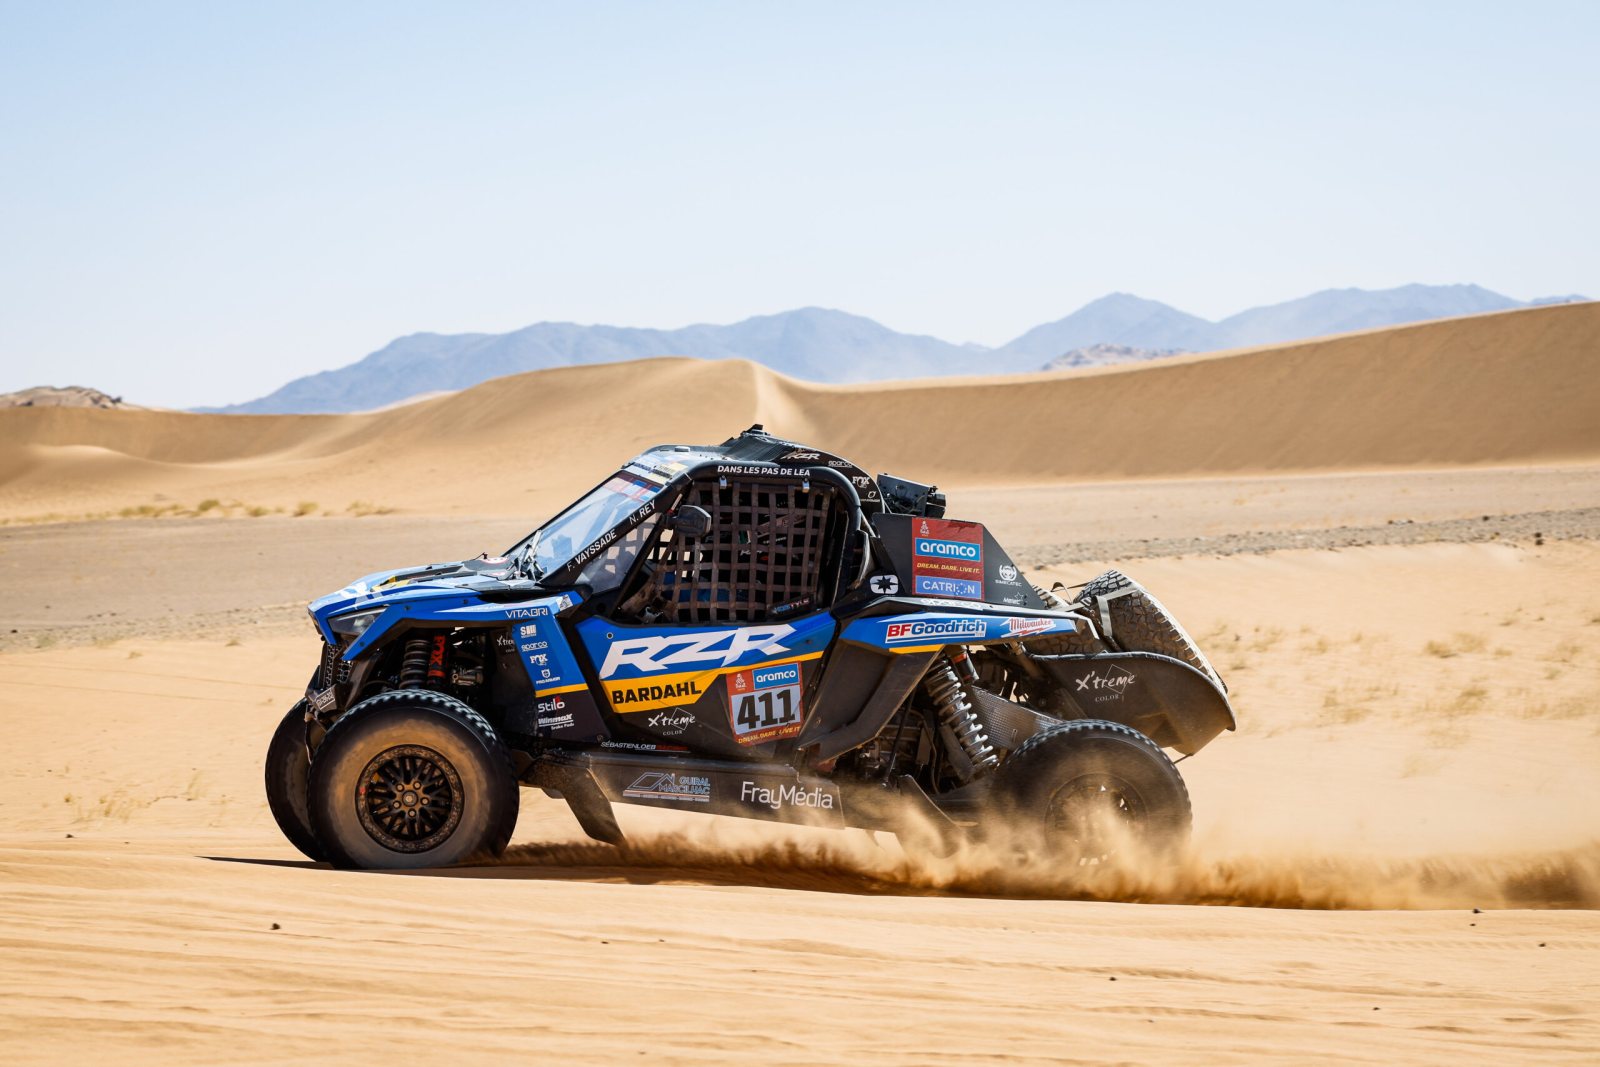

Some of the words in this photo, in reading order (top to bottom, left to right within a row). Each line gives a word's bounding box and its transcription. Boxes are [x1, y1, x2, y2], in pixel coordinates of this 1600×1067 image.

[717, 465, 742, 474] DANS
[743, 466, 760, 475] LES
[761, 467, 779, 475] PAS
[780, 468, 793, 476] DE
[794, 468, 811, 477] LEA
[852, 476, 870, 488] FOX
[629, 514, 639, 525] N.
[639, 499, 656, 517] REY
[566, 561, 575, 572] F.
[574, 528, 617, 565] VAYSSADE
[920, 542, 976, 558] aramco
[917, 562, 939, 570] DREAM.
[941, 564, 958, 572] DARE.
[922, 580, 976, 595] CATRION
[505, 607, 549, 619] VITABRI
[887, 619, 985, 637] BFGoodrich
[1010, 617, 1052, 630] Milwaukee
[521, 640, 549, 652] sparco
[599, 624, 797, 680] RZR
[530, 654, 548, 666] FOX
[756, 669, 797, 683] aramco
[612, 680, 702, 705] BARDAHL
[1095, 693, 1119, 703] COLOR
[538, 697, 565, 713] Stilo
[737, 688, 796, 729] 411
[538, 713, 573, 725] Winmax
[760, 730, 777, 738] DARE
[741, 780, 834, 809] FrayMédia
